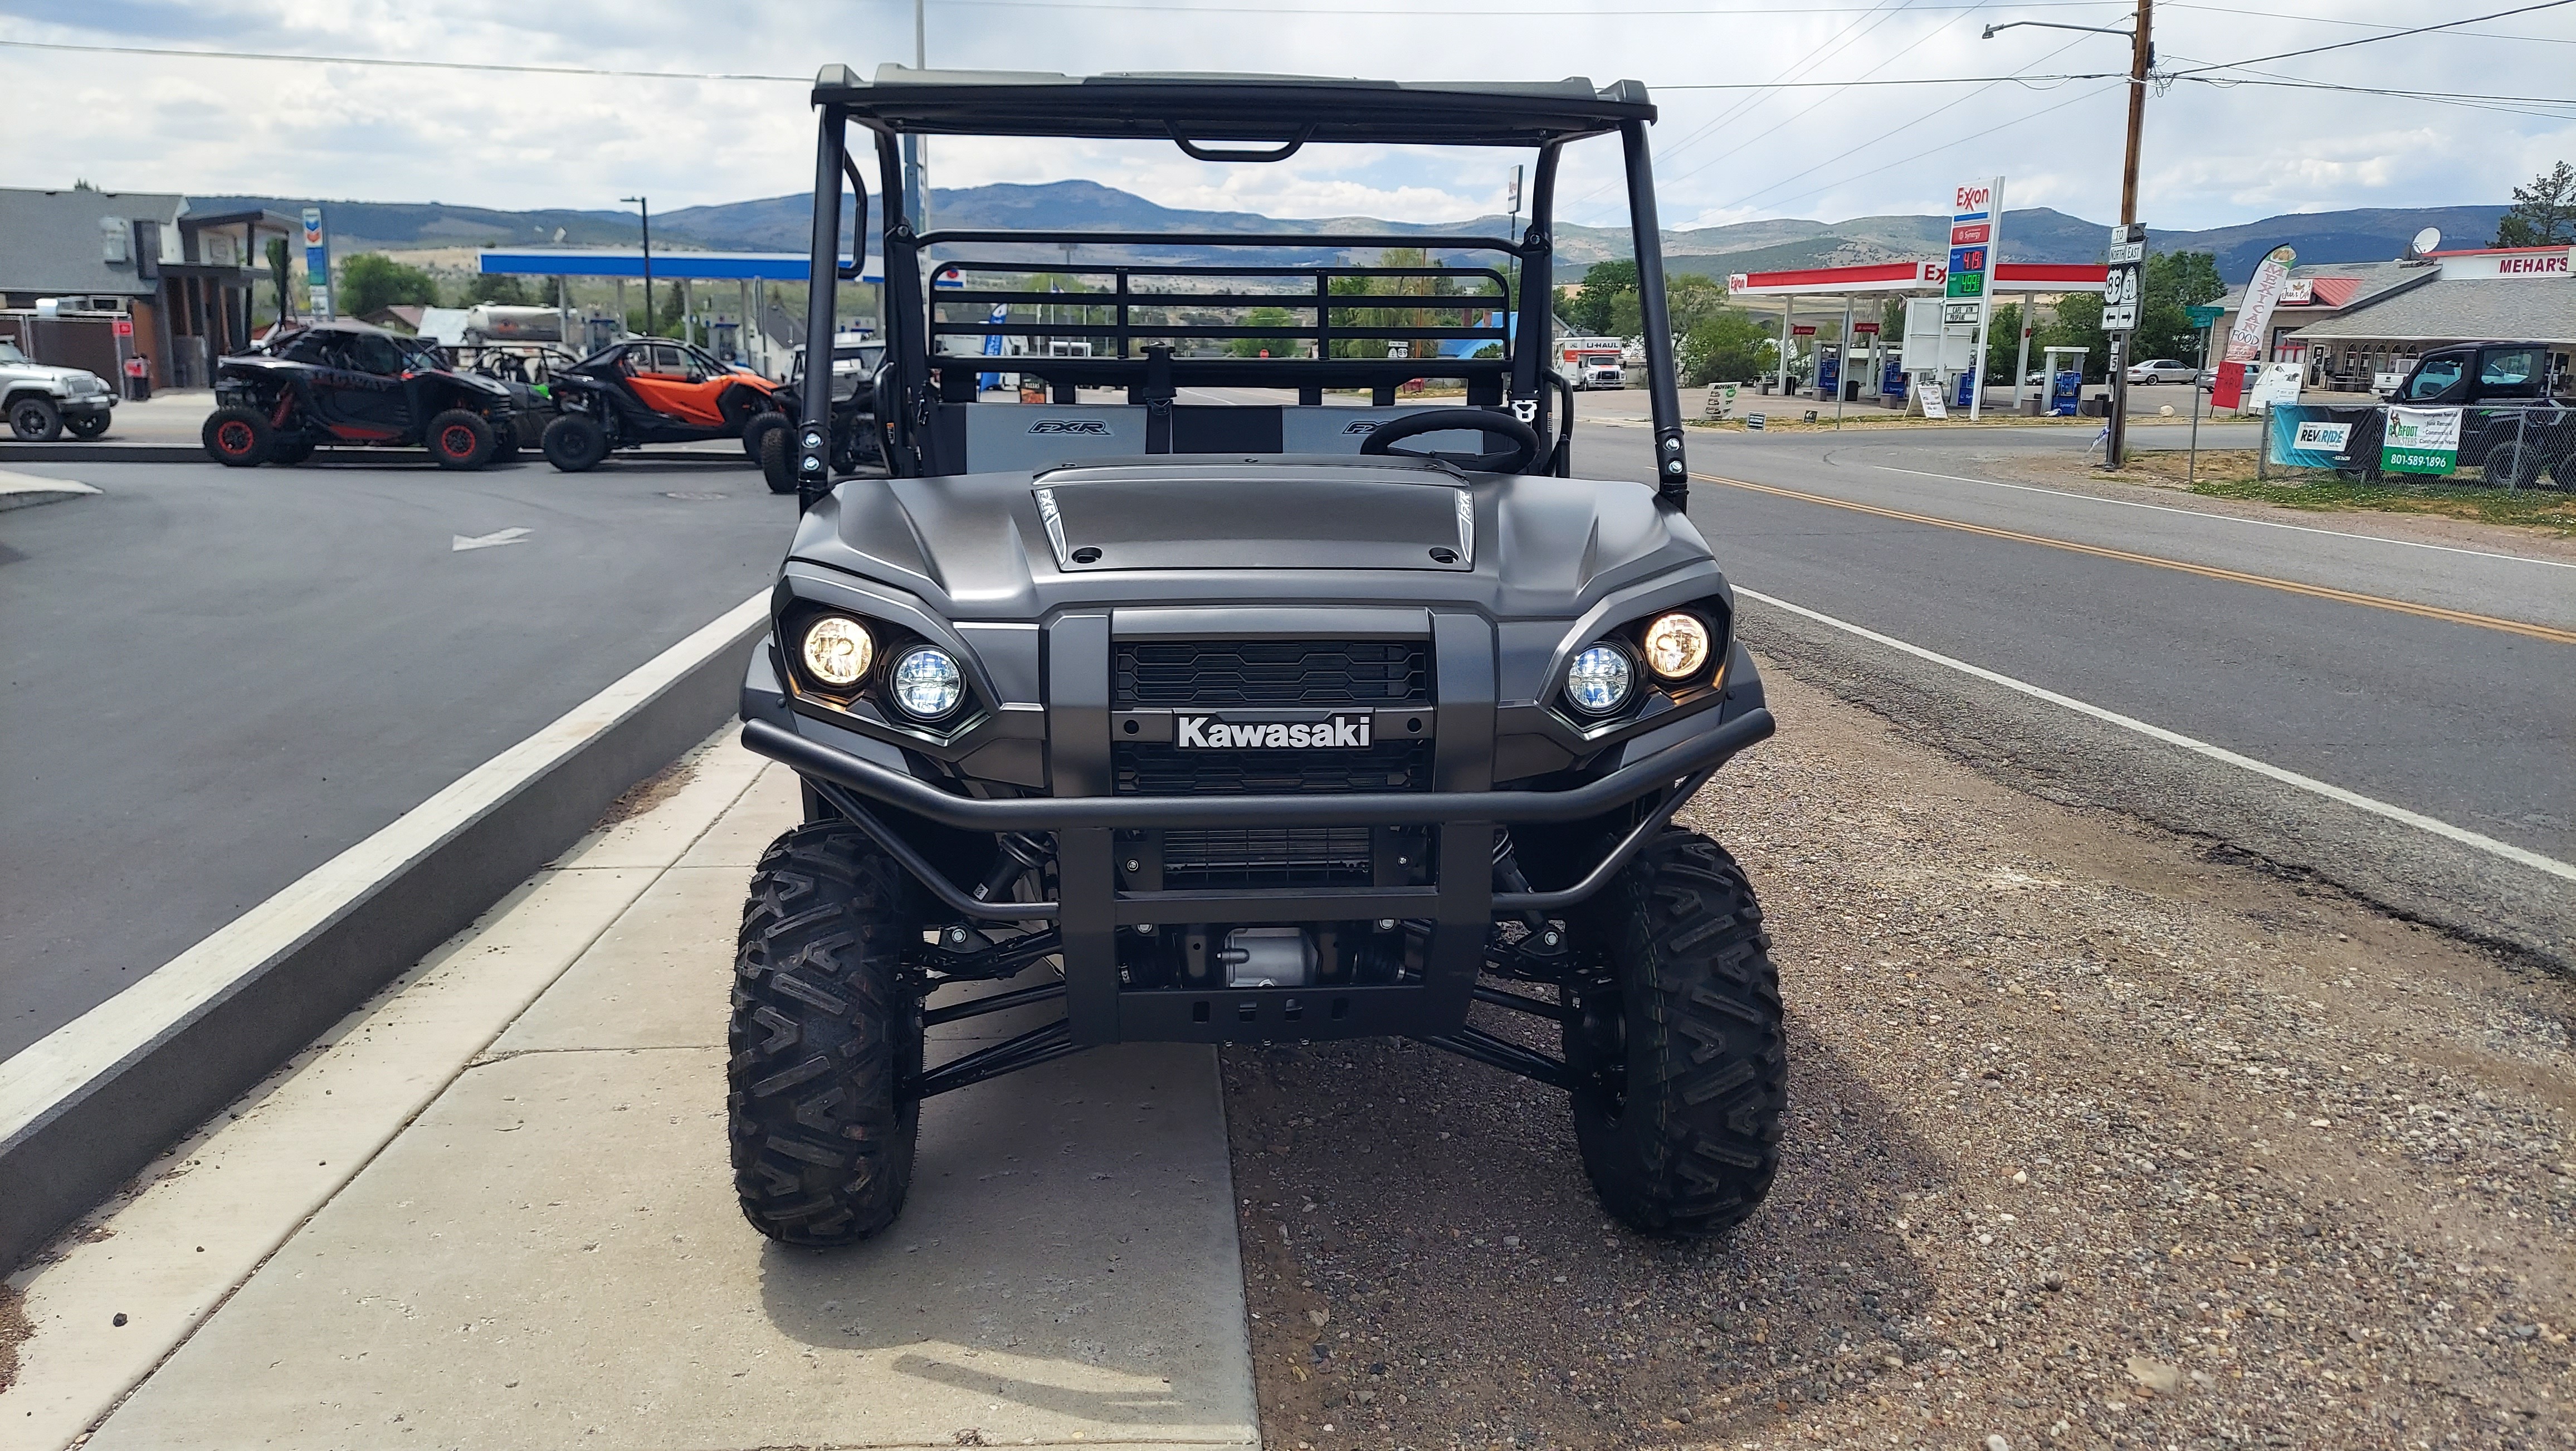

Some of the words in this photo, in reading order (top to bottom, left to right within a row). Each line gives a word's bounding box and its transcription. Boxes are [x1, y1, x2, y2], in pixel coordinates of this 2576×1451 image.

[1957, 187, 1989, 211] Exxon
[2116, 230, 2124, 241] TO
[2110, 249, 2125, 260] NORTH
[2128, 247, 2140, 259] EAST
[2499, 257, 2568, 273] MEHAR'S
[2107, 275, 2120, 295] 89
[2126, 279, 2134, 293] 31
[2242, 263, 2286, 334] MEXICAN
[2231, 329, 2260, 345] FOOD
[1028, 420, 1111, 435] FXR
[1342, 421, 1391, 434] FX
[2390, 454, 2446, 468] 801-589-1896
[1179, 717, 1370, 748] Kawasaki
